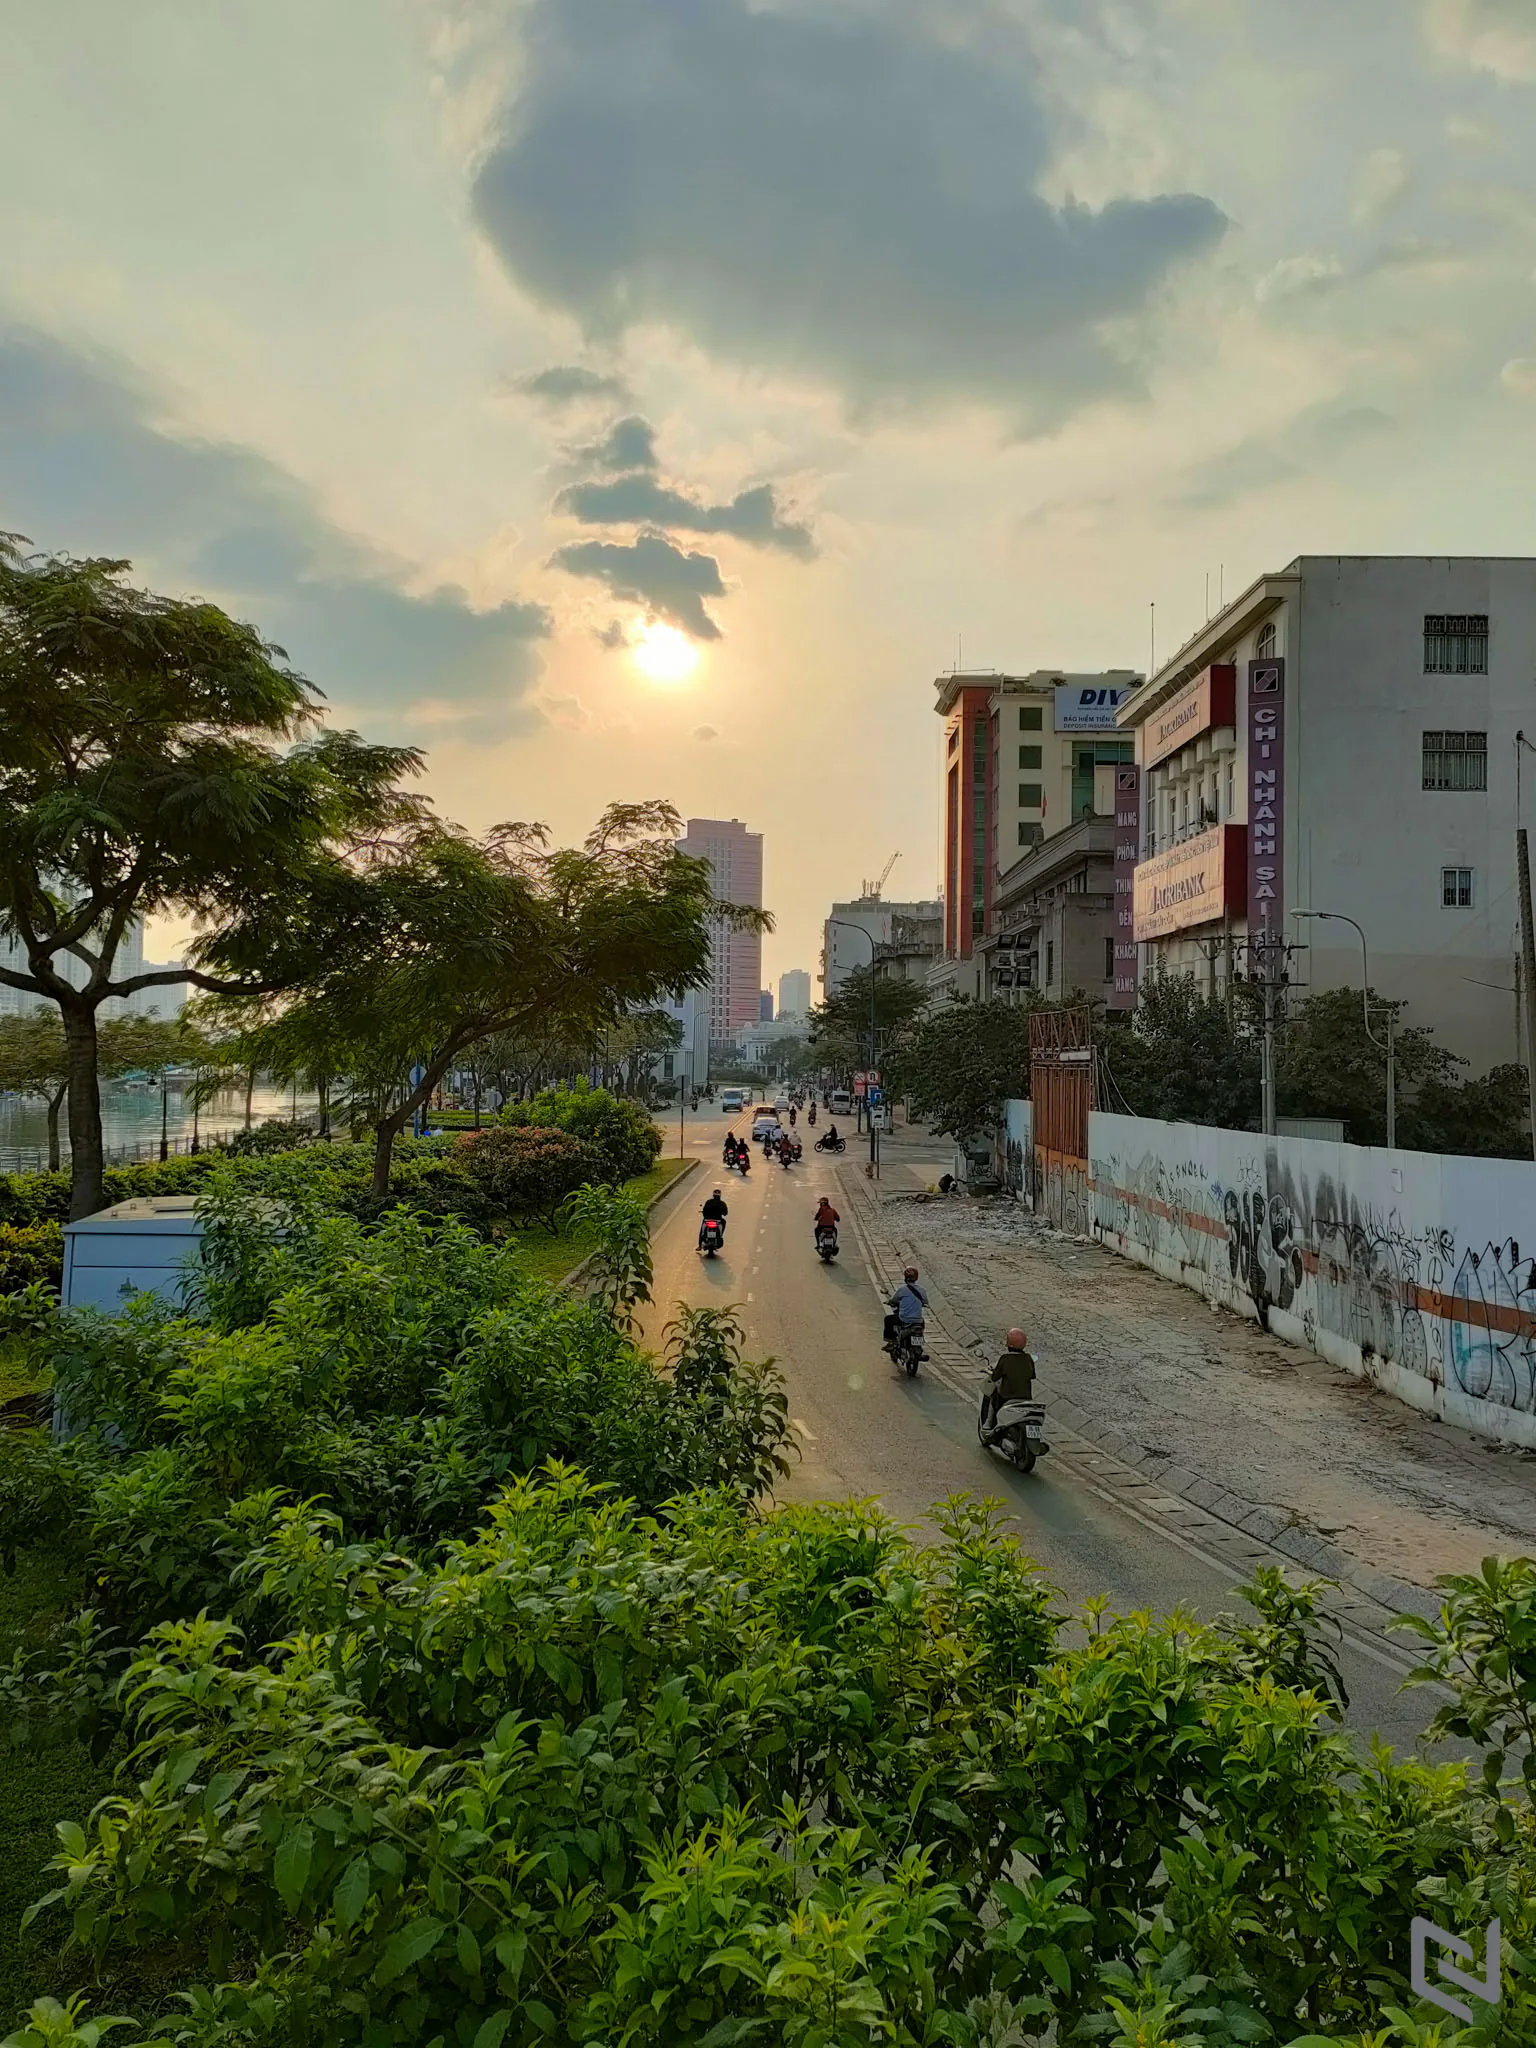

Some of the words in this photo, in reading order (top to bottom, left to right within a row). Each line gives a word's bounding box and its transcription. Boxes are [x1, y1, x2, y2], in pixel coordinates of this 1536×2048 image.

[1254, 709, 1277, 759] CHI
[1117, 811, 1137, 827] MANG
[1254, 769, 1276, 855] NHÁNH
[1114, 940, 1137, 960] KHÁCH
[1115, 974, 1134, 993] HÀNG
